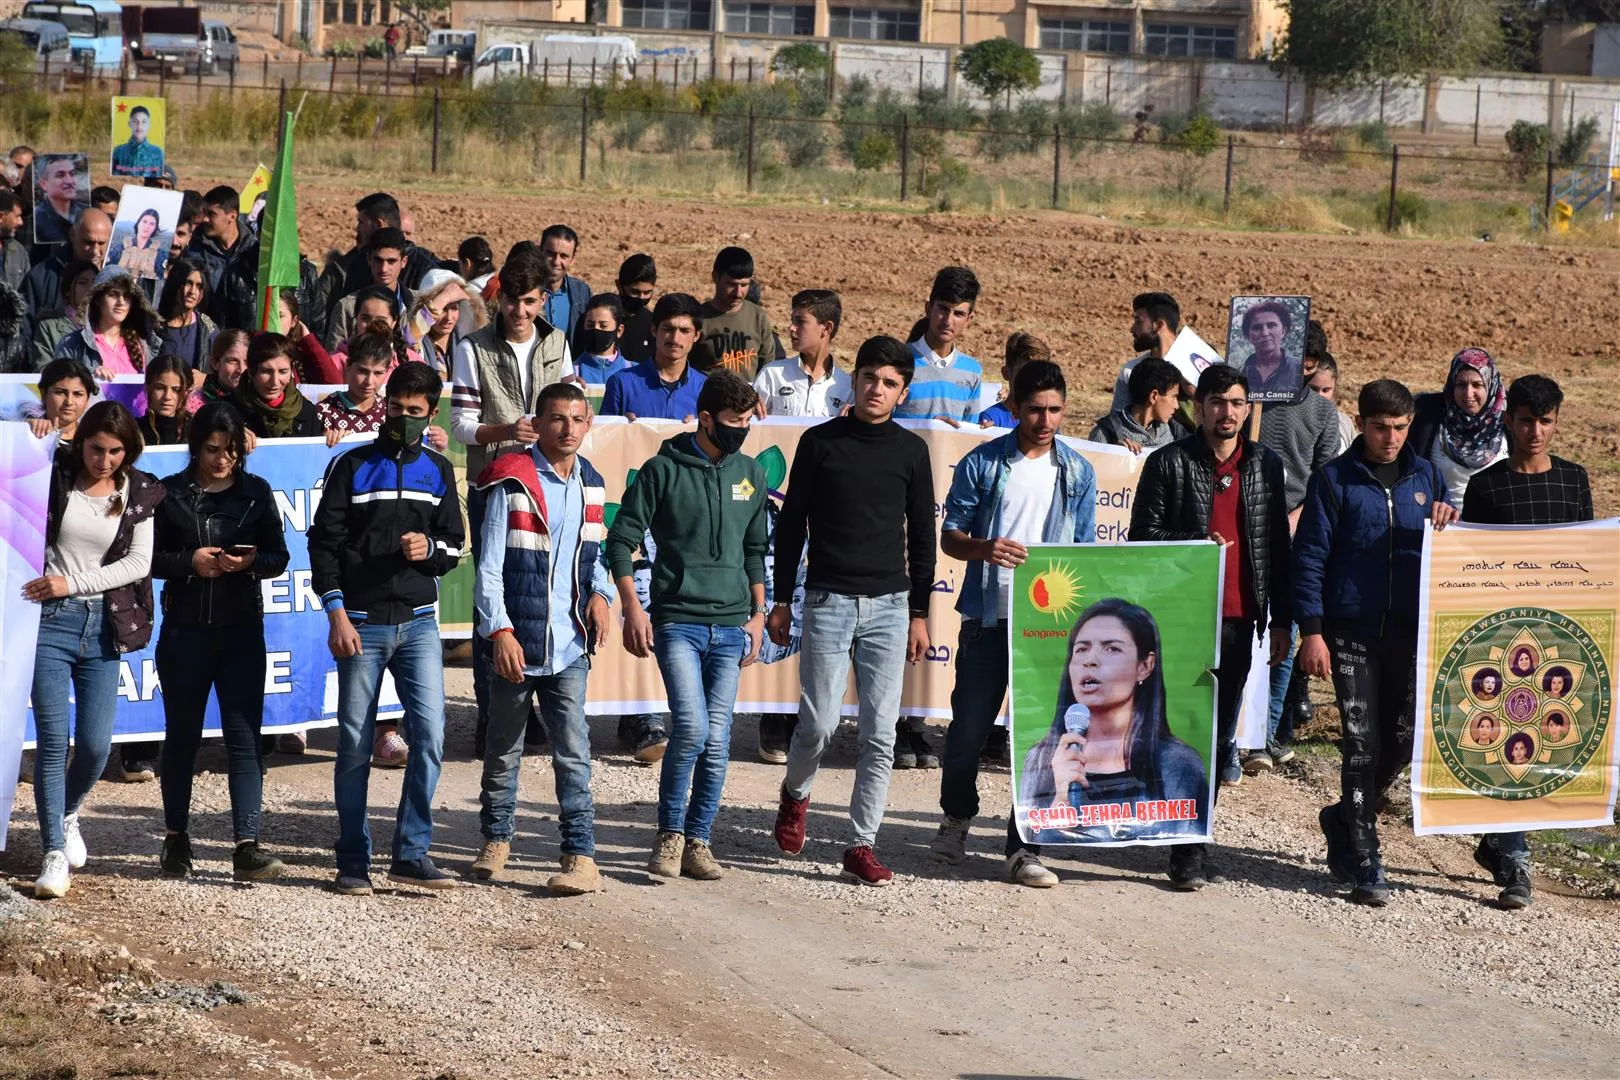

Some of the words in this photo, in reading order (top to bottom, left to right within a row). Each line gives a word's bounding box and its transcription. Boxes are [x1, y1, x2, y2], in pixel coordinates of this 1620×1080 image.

[1022, 629, 1067, 639] Kongreya
[1438, 667, 1449, 681] BI
[1449, 609, 1551, 660] BERXWEDANIYA
[1027, 801, 1078, 834] ŞEHÎD
[1080, 803, 1132, 826] ZEHRA
[1136, 799, 1198, 825] BERKEL
